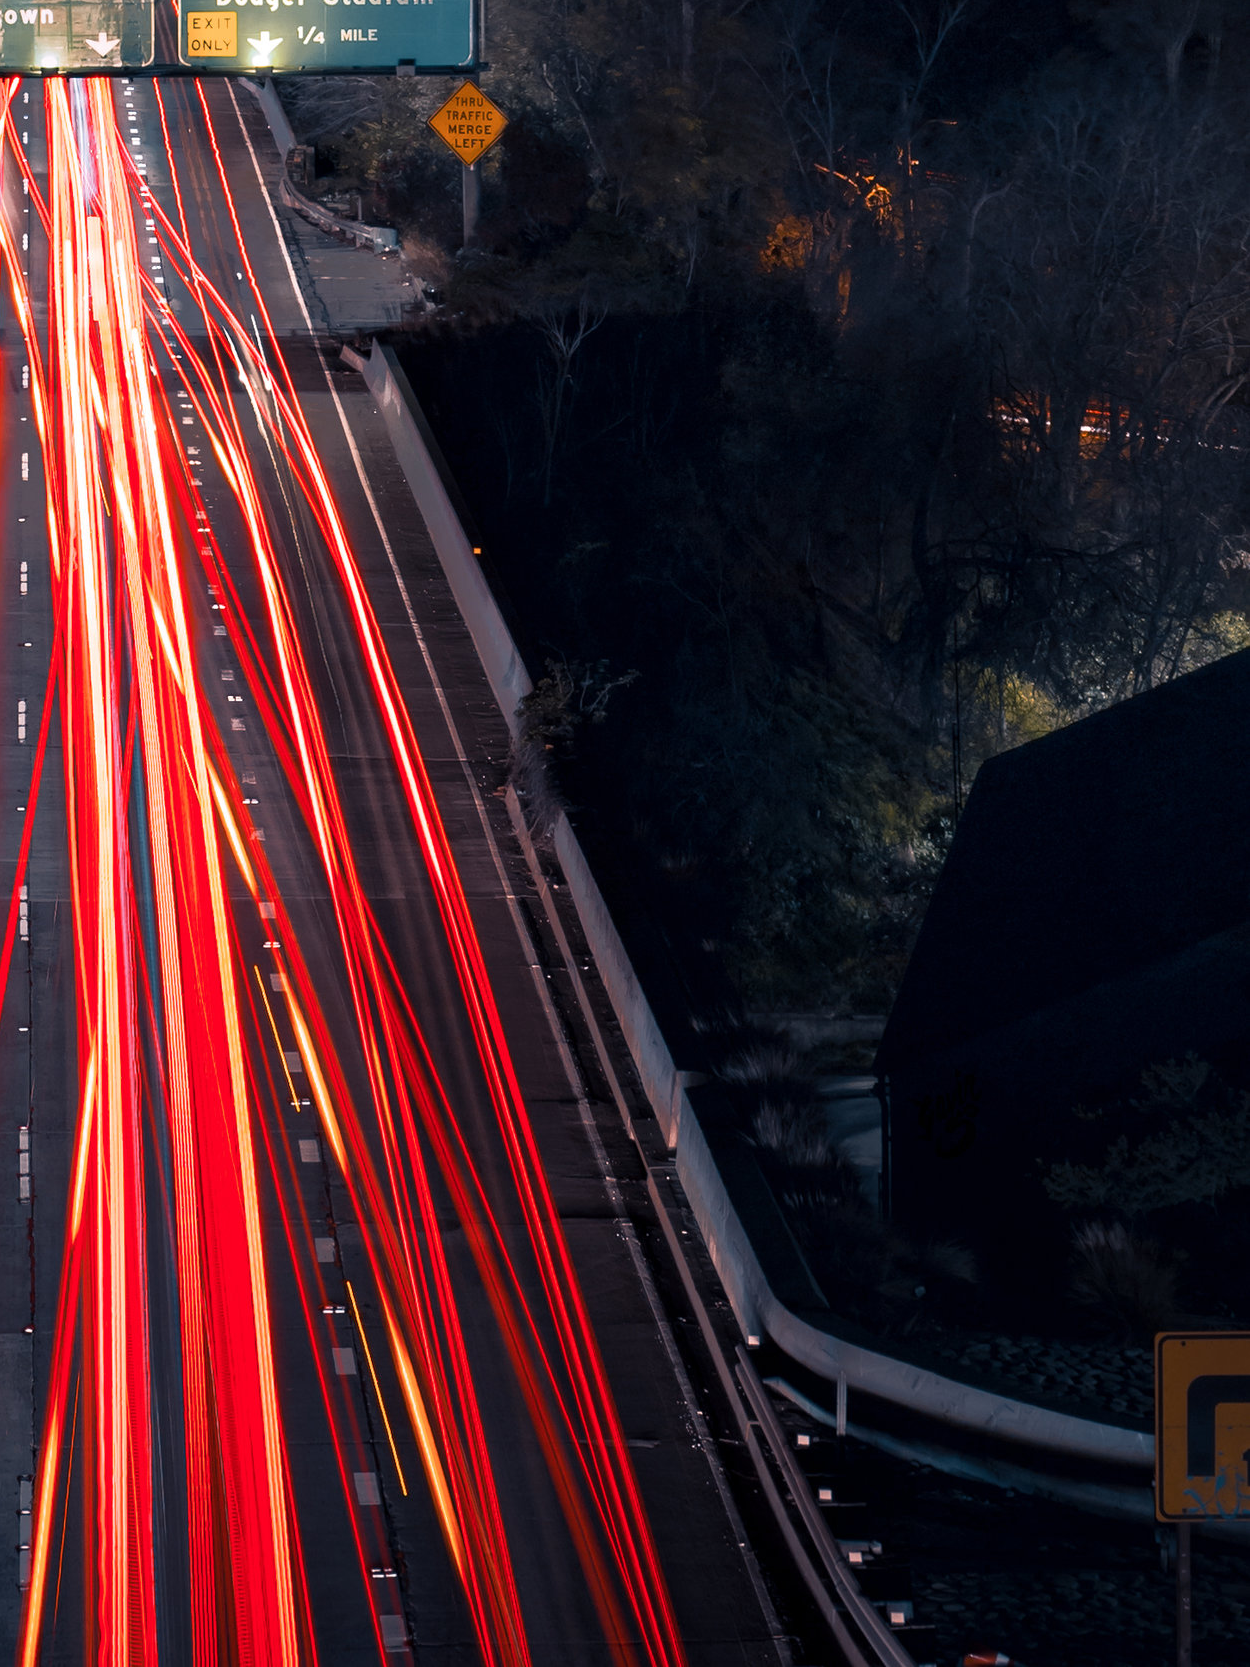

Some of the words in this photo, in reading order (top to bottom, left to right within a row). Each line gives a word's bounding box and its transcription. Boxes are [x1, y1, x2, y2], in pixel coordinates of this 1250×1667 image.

[192, 18, 232, 30] EXIT
[340, 29, 379, 42] MILE
[191, 39, 232, 52] ONLY
[455, 97, 484, 107] THRU
[446, 110, 493, 121] TRAFFIC
[448, 124, 492, 135] MERGE
[455, 139, 485, 148] LEFT
